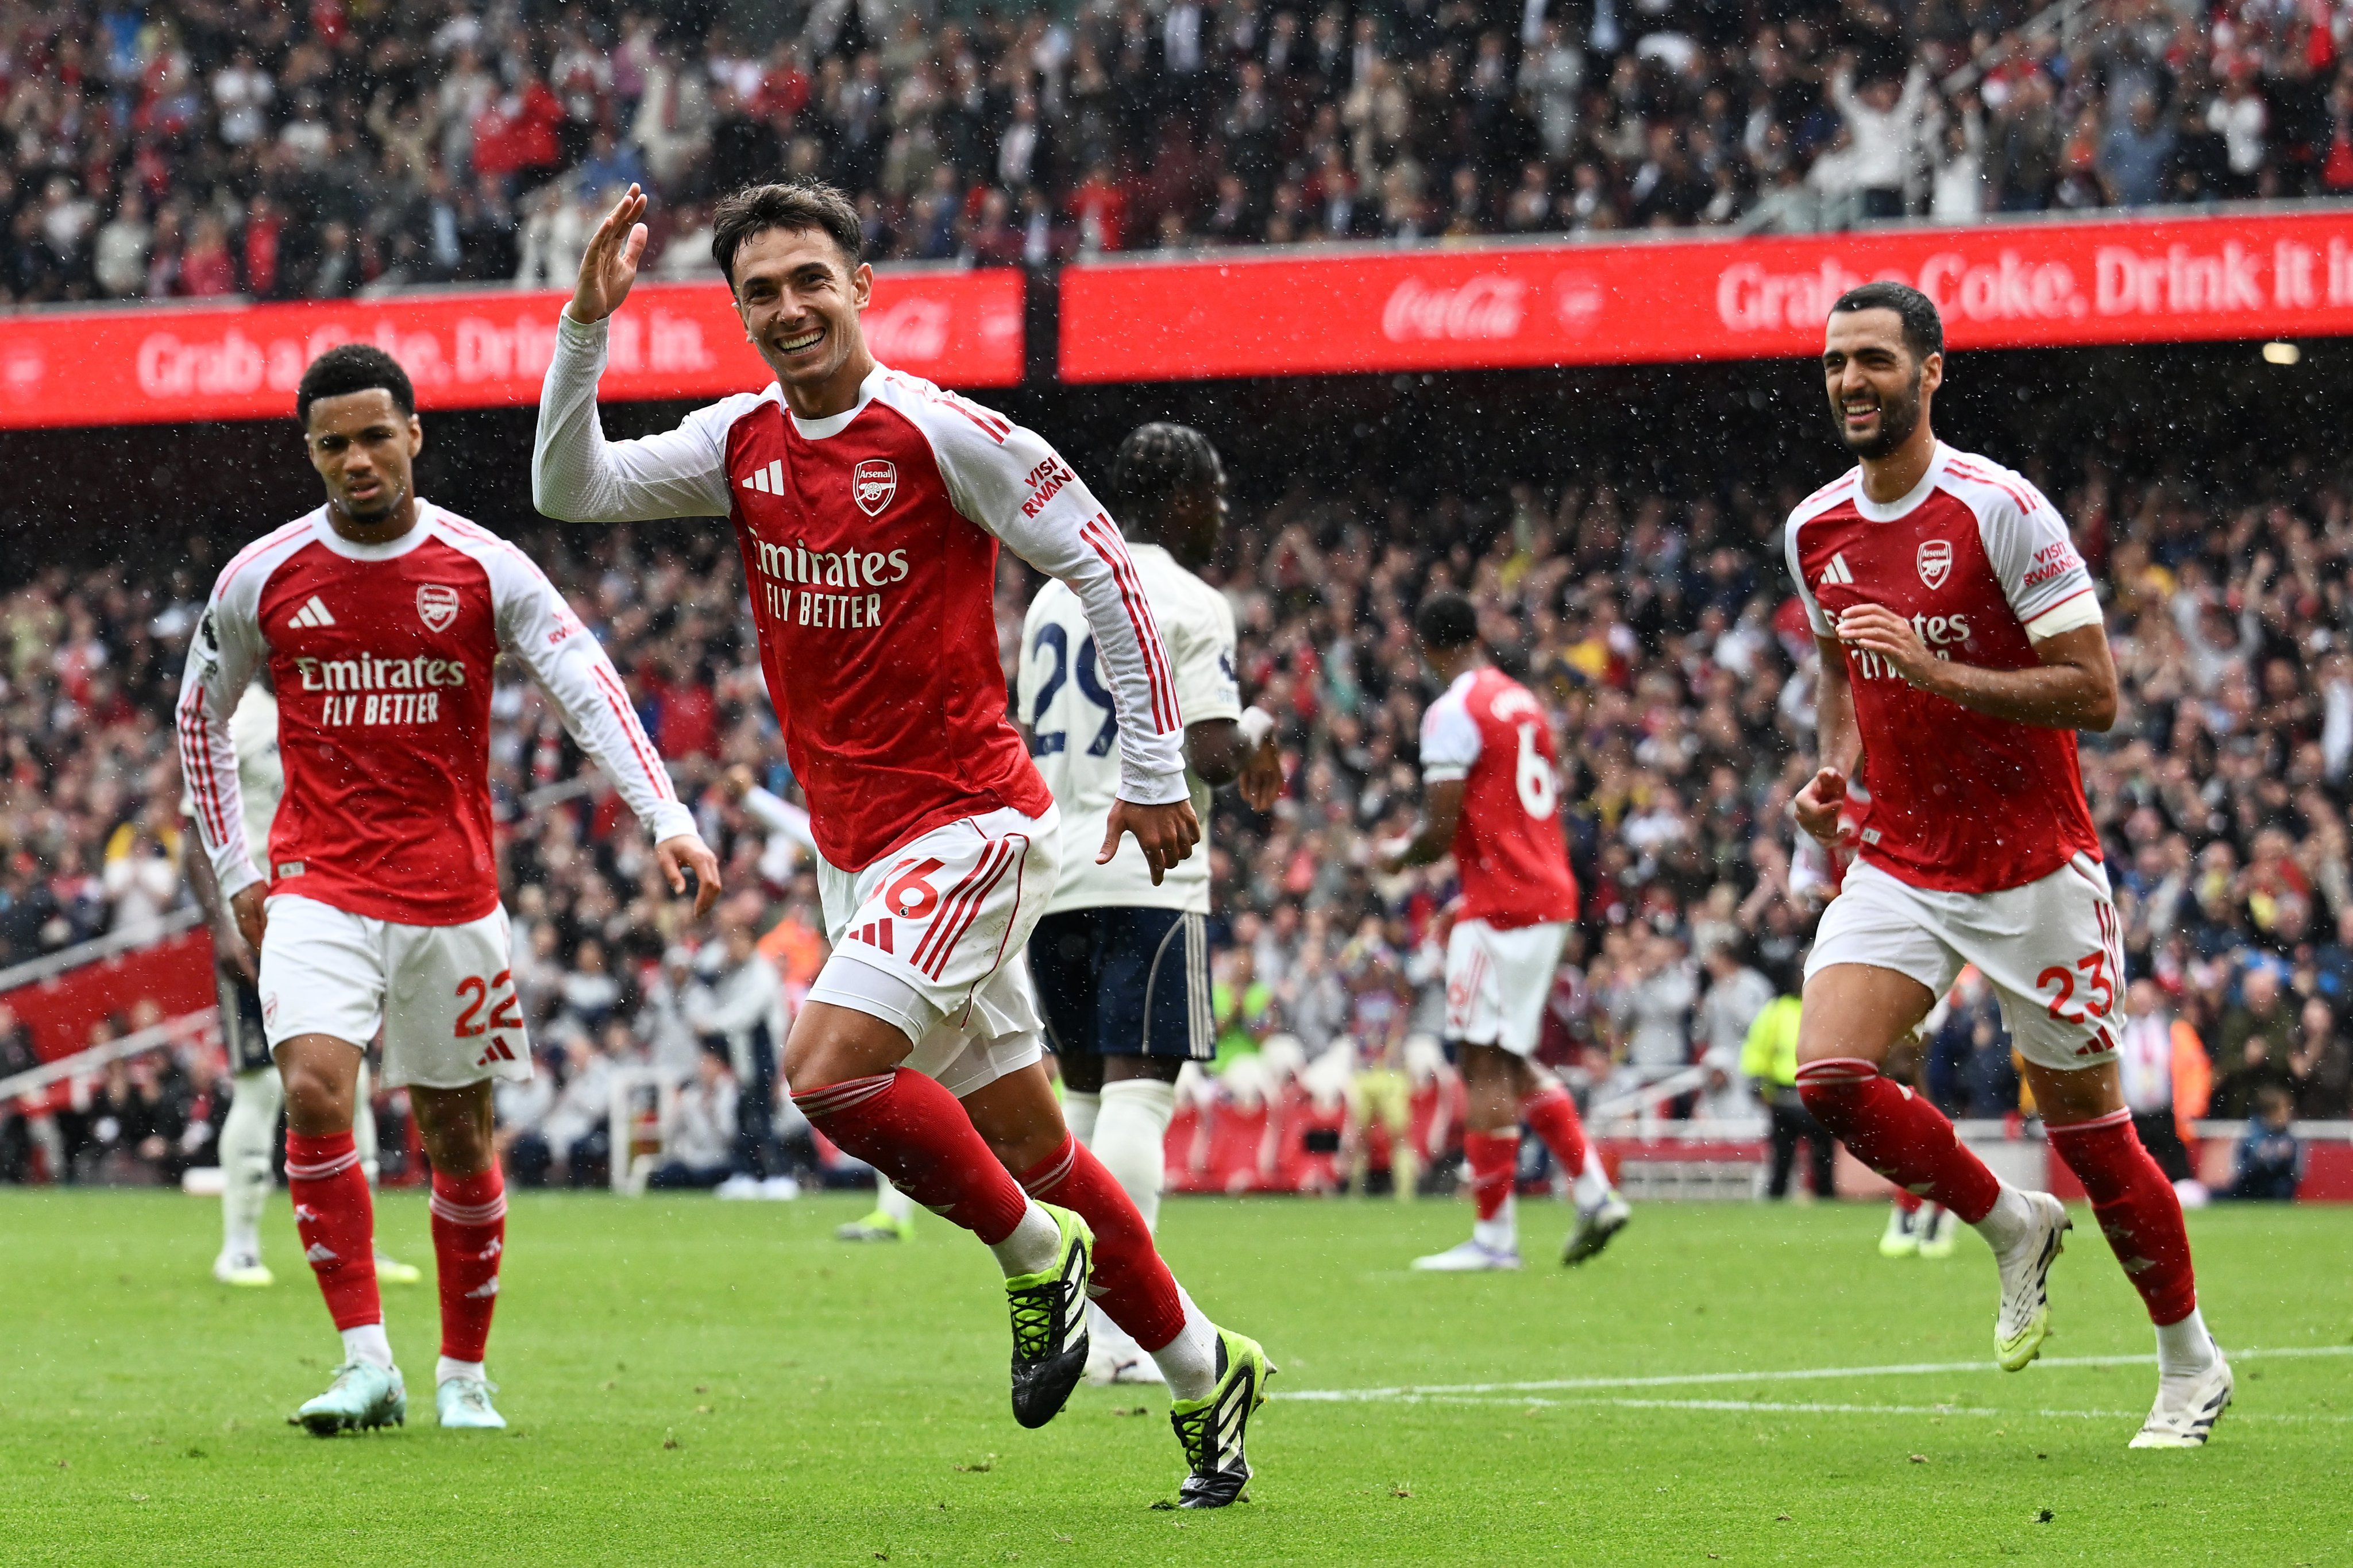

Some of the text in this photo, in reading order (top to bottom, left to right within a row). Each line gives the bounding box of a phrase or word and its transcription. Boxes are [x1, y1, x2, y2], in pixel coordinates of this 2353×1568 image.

[1918, 249, 2089, 325] Coke.
[2095, 238, 2265, 317] Drink
[2273, 237, 2315, 309] it
[136, 325, 264, 399] Grab
[859, 469, 890, 478] Arsenal
[1021, 465, 1076, 519] RWAN
[2023, 554, 2080, 587] RWAND
[2033, 542, 2067, 564] VISIT
[766, 582, 881, 629] FLY BETTER
[295, 651, 466, 692] Emirates
[322, 692, 439, 727] FLY BETTER
[1516, 721, 1557, 821] 6
[454, 968, 524, 1038] 22
[2036, 949, 2113, 1025] 23
